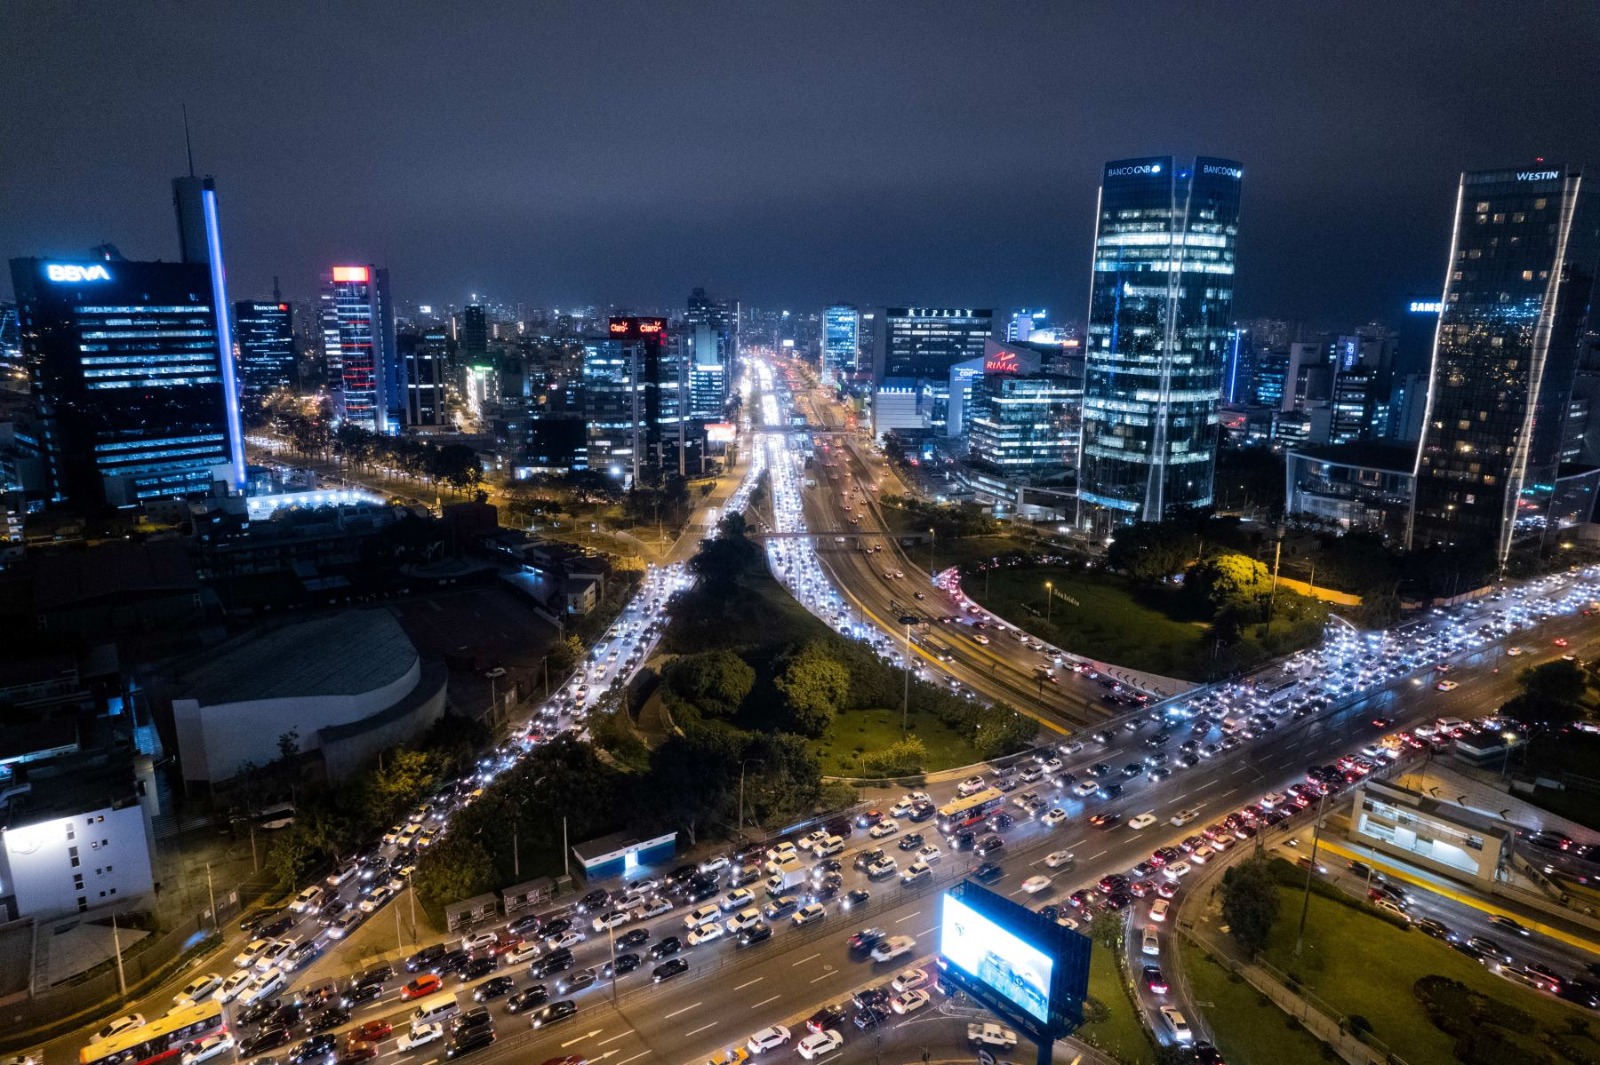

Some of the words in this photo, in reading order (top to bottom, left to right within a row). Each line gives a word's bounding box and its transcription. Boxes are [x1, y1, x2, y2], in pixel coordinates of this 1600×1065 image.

[1108, 166, 1133, 177] BANCO
[1133, 165, 1151, 174] GNB
[1203, 164, 1227, 176] BANCO
[1516, 171, 1559, 181] WESTIN
[48, 264, 110, 282] BBVA
[908, 309, 973, 317] RIPLEY
[610, 323, 626, 333] Claro
[640, 324, 659, 333] Claro
[986, 361, 1019, 372] RIMAC
